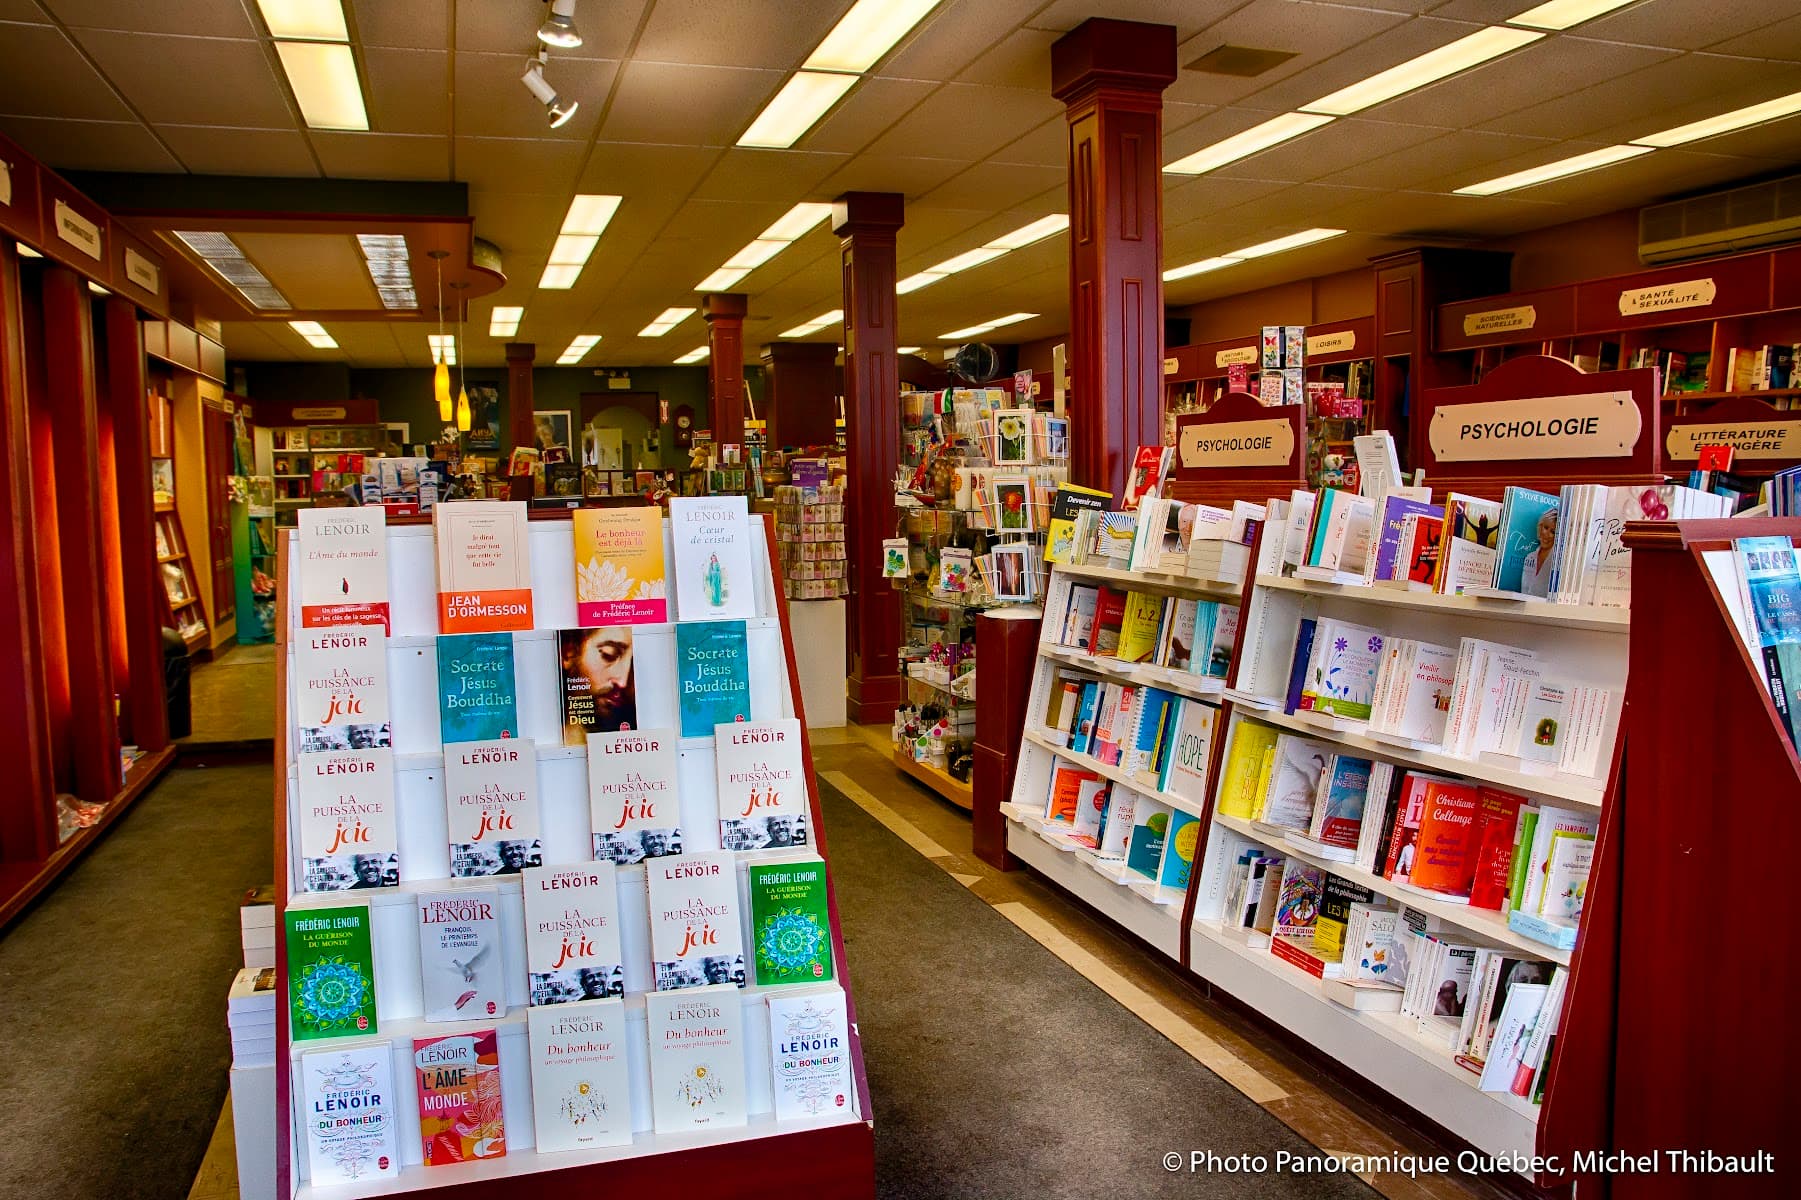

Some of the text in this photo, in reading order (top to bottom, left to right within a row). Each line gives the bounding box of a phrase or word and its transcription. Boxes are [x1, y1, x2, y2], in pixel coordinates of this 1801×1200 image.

[1640, 289, 1674, 300] SANTÉ
[1640, 292, 1699, 308] SEXUALITÉ
[1476, 318, 1522, 330] NATURELLES
[1480, 312, 1516, 323] SCIENCES
[1316, 338, 1342, 348] LOISIRS
[1460, 417, 1599, 440] PSYCHOLOGIE
[1690, 430, 1787, 440] LITTÉRATURE
[1196, 436, 1272, 452] PSYCHOLOGIE
[1068, 496, 1102, 508] Devenir zen
[1520, 491, 1538, 502] SYLVIE
[686, 511, 736, 522] LENOIR
[314, 524, 370, 536] LENOIR
[596, 530, 646, 538] Le bonheur
[698, 526, 725, 534] Cœur
[690, 534, 734, 545] de cristal
[338, 550, 348, 559] du
[350, 550, 378, 559] monde
[448, 595, 480, 606] JEAN
[1768, 594, 1790, 604] BIG
[448, 604, 527, 618] D'ORMESSON
[610, 602, 636, 610] Préface
[592, 608, 654, 618] de Frédéric Lenoir
[312, 638, 368, 650] LENOIR
[688, 647, 738, 661] Socrate
[334, 668, 350, 678] LA
[451, 660, 505, 674] Socrate
[697, 664, 731, 680] Jésus
[308, 677, 375, 689] PUISSANCE
[460, 677, 496, 694] Jésus
[567, 676, 590, 684] Frédéric
[567, 683, 592, 691] Lenoir
[684, 680, 746, 694] Bouddha
[448, 694, 512, 708] Bouddha
[568, 700, 594, 710] Jésus
[570, 715, 596, 725] Dieu
[732, 732, 785, 745] LENOIR
[605, 742, 660, 754] LENOIR
[1181, 731, 1204, 772] HOPE
[462, 752, 518, 764] LENOIR
[317, 762, 375, 776] LENOIR
[753, 762, 768, 772] LA
[627, 774, 642, 782] LA
[730, 770, 792, 783] PUISSANCE
[484, 784, 500, 793] LA
[602, 780, 667, 794] PUISSANCE
[340, 795, 356, 805] LA
[459, 792, 526, 806] PUISSANCE
[1436, 794, 1476, 808] Christiane
[313, 804, 383, 817] PUISSANCE
[1434, 808, 1472, 827] Collange
[666, 865, 720, 880] LENOIR
[760, 872, 817, 885] FRÉDÉRIC LENOIR
[542, 876, 598, 890] LENOIR
[1334, 886, 1340, 894] la
[1340, 889, 1367, 902] philosophie
[430, 899, 478, 910] FRÉDÉRIC
[688, 898, 704, 908] LA
[1328, 902, 1340, 916] LES
[422, 904, 494, 924] LENOIR
[564, 909, 580, 920] LA
[662, 905, 729, 920] PUISSANCE
[295, 916, 360, 932] FRÉDÉRIC LENOIR
[539, 916, 607, 932] PUISSANCE
[314, 932, 354, 940] GUÉRISON
[320, 939, 349, 947] MONDE
[669, 1008, 720, 1020] LENOIR
[552, 1022, 604, 1036] LENOIR
[666, 1027, 728, 1040] Du bonheur
[548, 1041, 612, 1055] Du bonheur
[781, 1038, 838, 1053] LENOIR
[421, 1048, 467, 1063] LENOIR
[784, 1056, 840, 1069] DU BONHEUR
[316, 1094, 381, 1112] LENOIR
[424, 1092, 469, 1112] MONDE
[320, 1115, 382, 1129] DU BONHEUR
